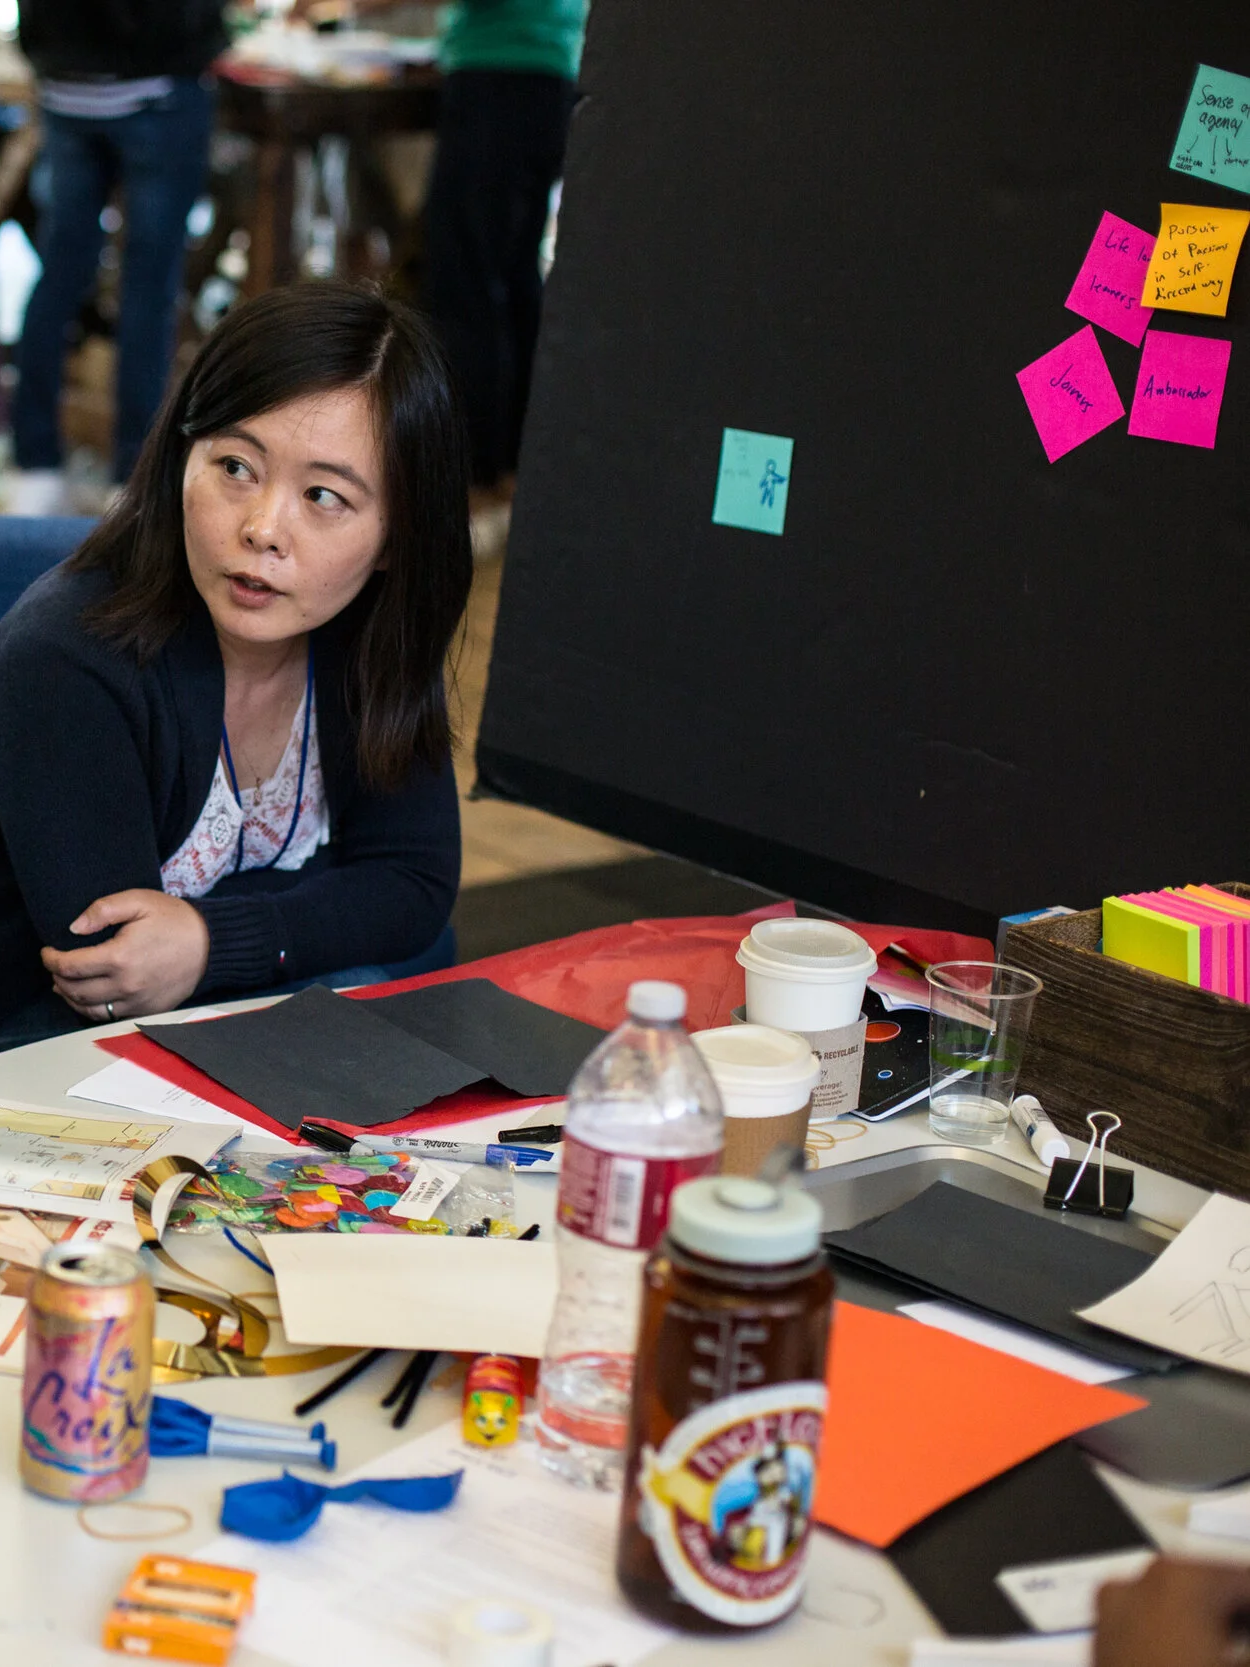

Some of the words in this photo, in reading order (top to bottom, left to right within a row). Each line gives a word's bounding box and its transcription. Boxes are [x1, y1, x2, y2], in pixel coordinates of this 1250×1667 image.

[1196, 84, 1234, 109] Sense
[1199, 112, 1243, 138] agency
[1137, 245, 1151, 262] lo
[1201, 279, 1224, 297] way
[1143, 374, 1212, 401] Ambassador
[823, 1044, 859, 1060] RECYCLABLE
